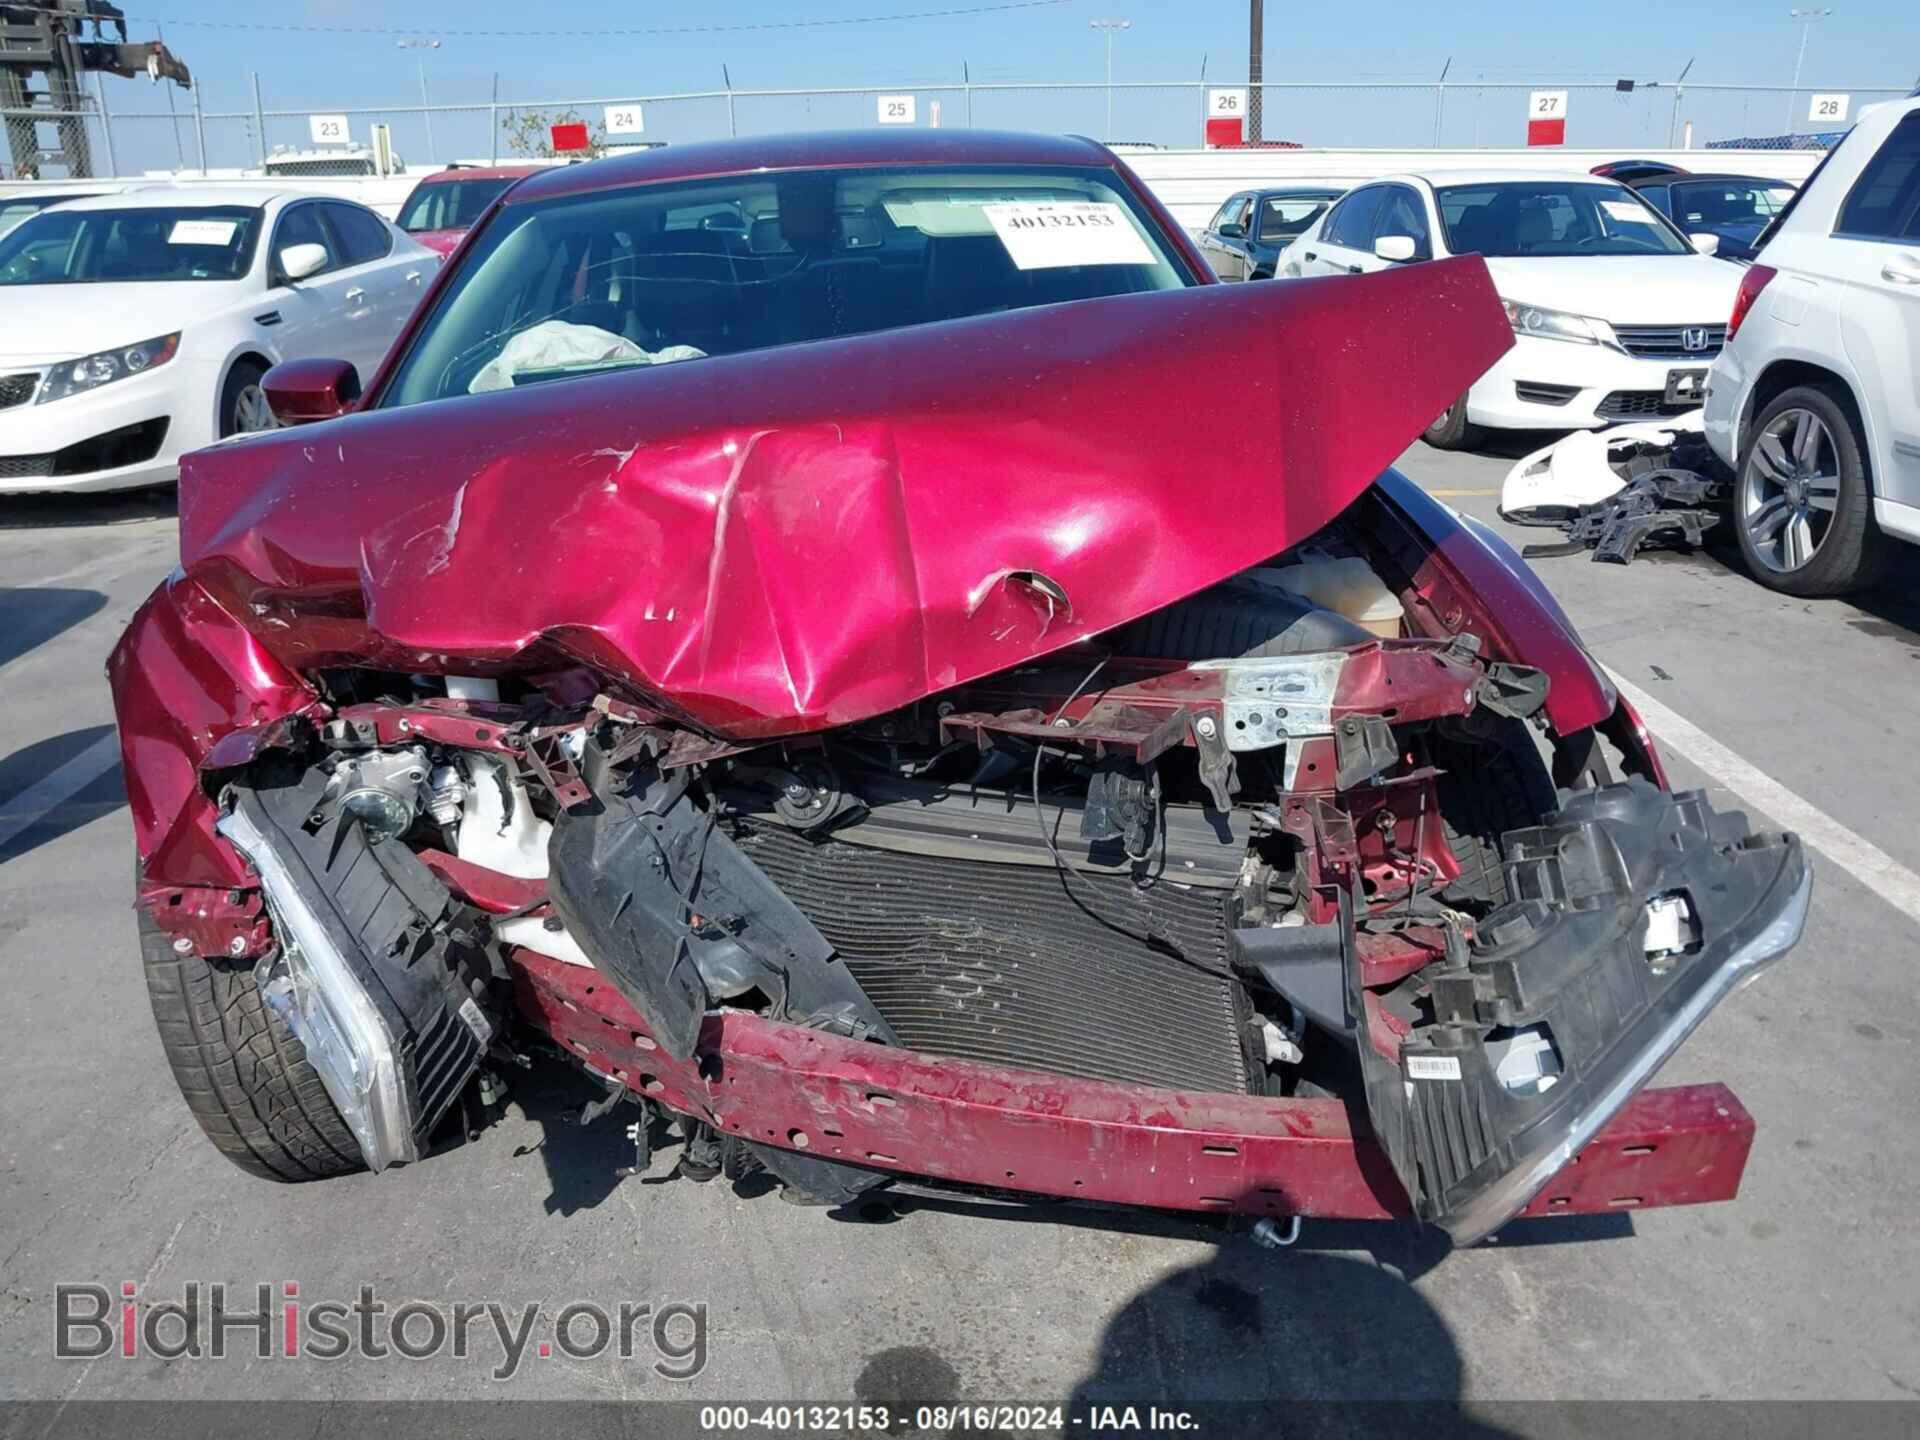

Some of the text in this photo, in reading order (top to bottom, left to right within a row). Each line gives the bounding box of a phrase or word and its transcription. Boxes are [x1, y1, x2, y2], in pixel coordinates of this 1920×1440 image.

[888, 103, 907, 117] 25
[1218, 95, 1238, 110] 26
[1538, 97, 1559, 112] 27
[1819, 100, 1840, 115] 28
[615, 112, 633, 127] 24
[320, 122, 340, 137] 23
[1008, 213, 1116, 230] 40132153
